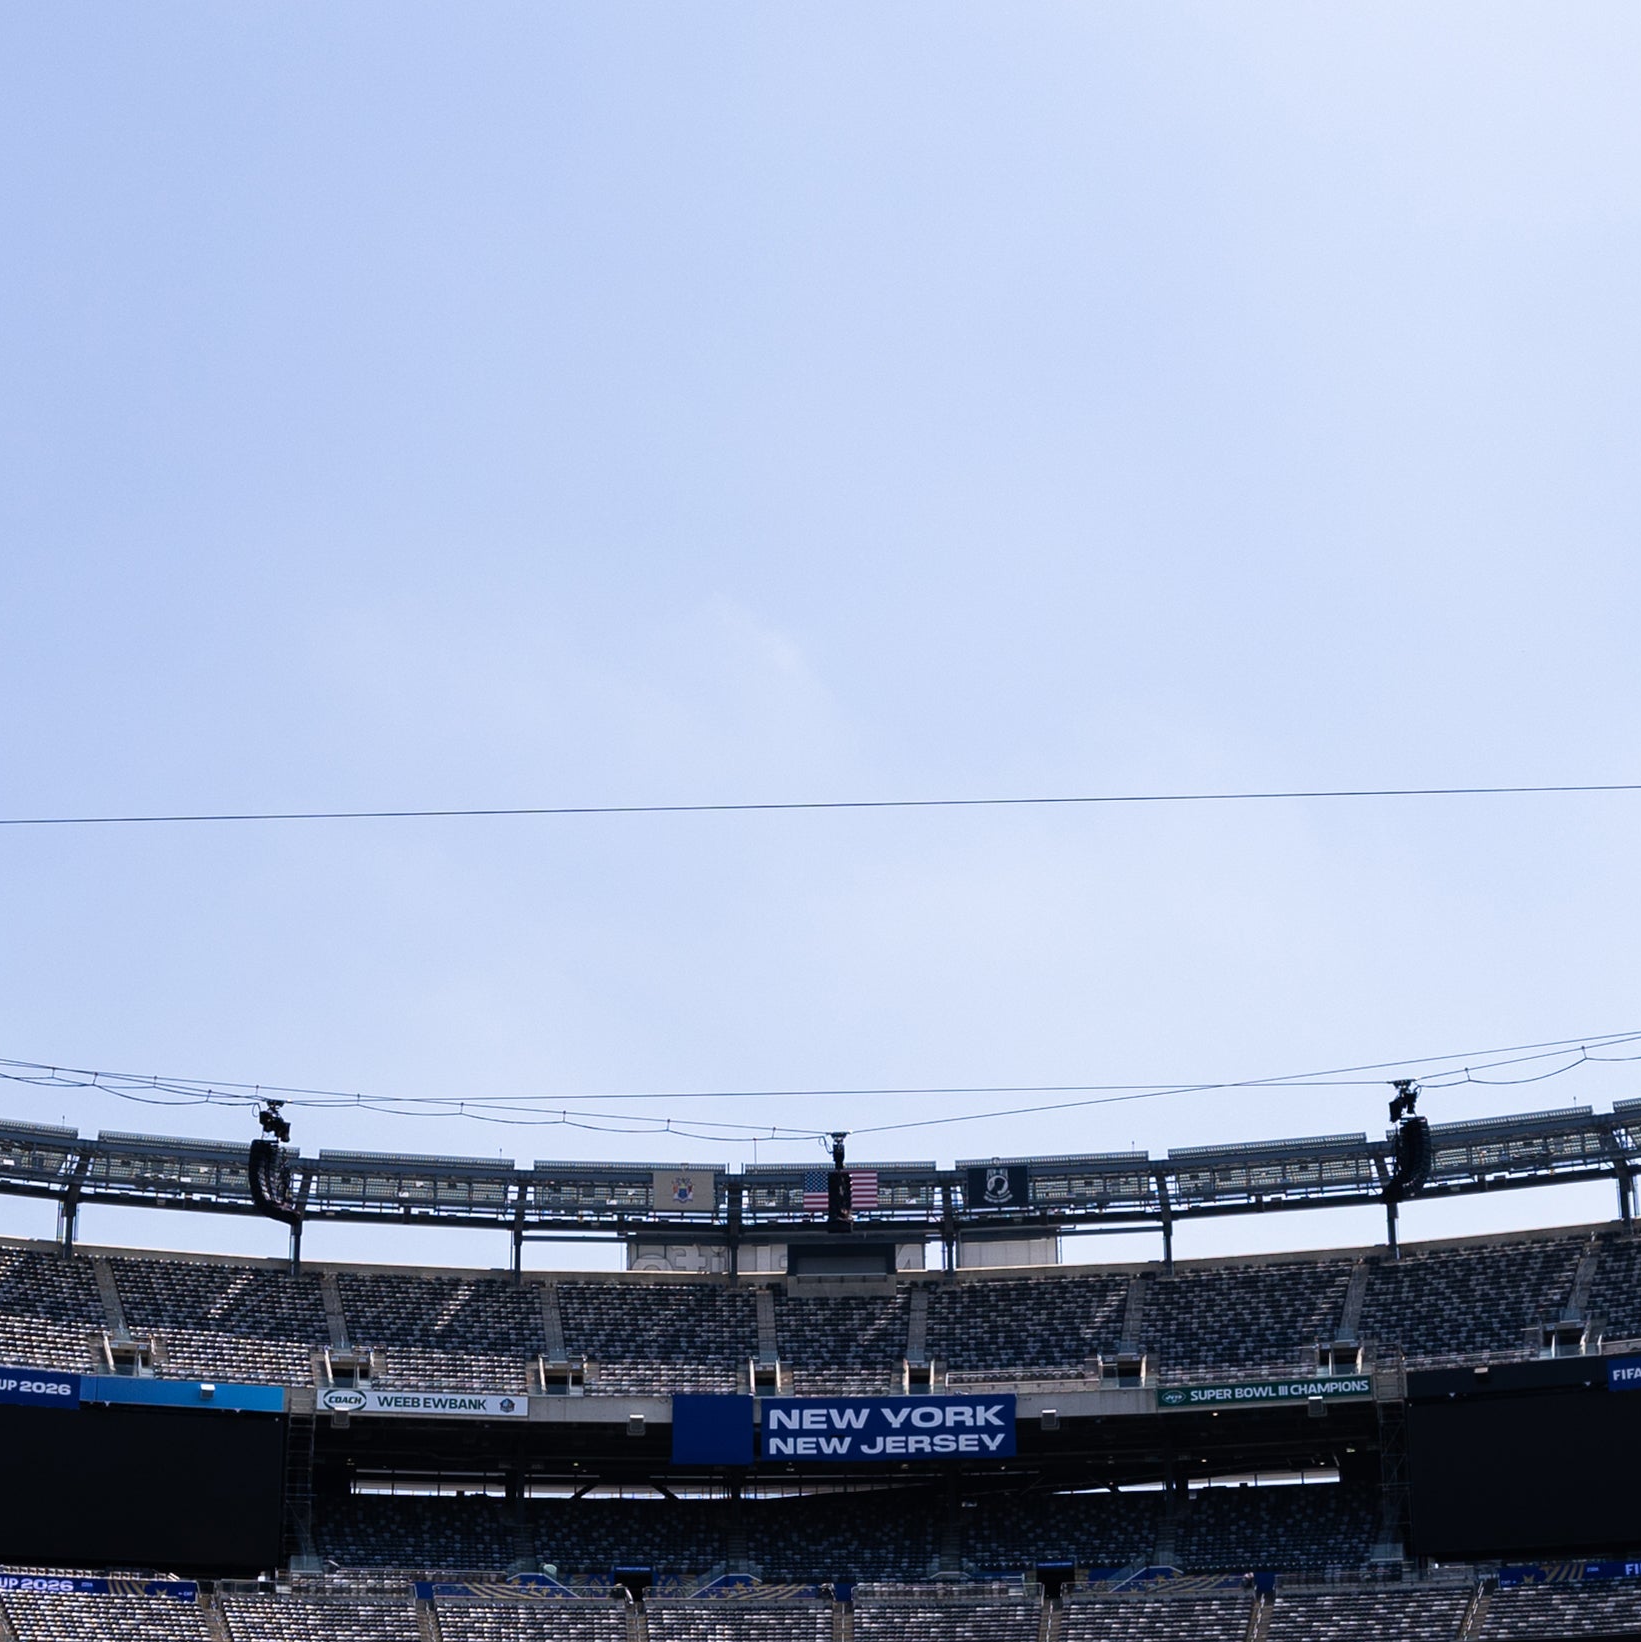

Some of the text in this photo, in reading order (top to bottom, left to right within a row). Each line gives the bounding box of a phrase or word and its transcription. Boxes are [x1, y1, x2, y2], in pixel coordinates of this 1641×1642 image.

[19, 1380, 72, 1396] 2026
[1190, 1380, 1369, 1401] SUPER BOWL III CHAMPIONS
[328, 1395, 362, 1405] COACH
[377, 1395, 487, 1410] WEEB EWBANK
[769, 1405, 1006, 1429] NEW YORK
[769, 1433, 1006, 1455] NEW JERSEY
[20, 1578, 74, 1592] 2026
